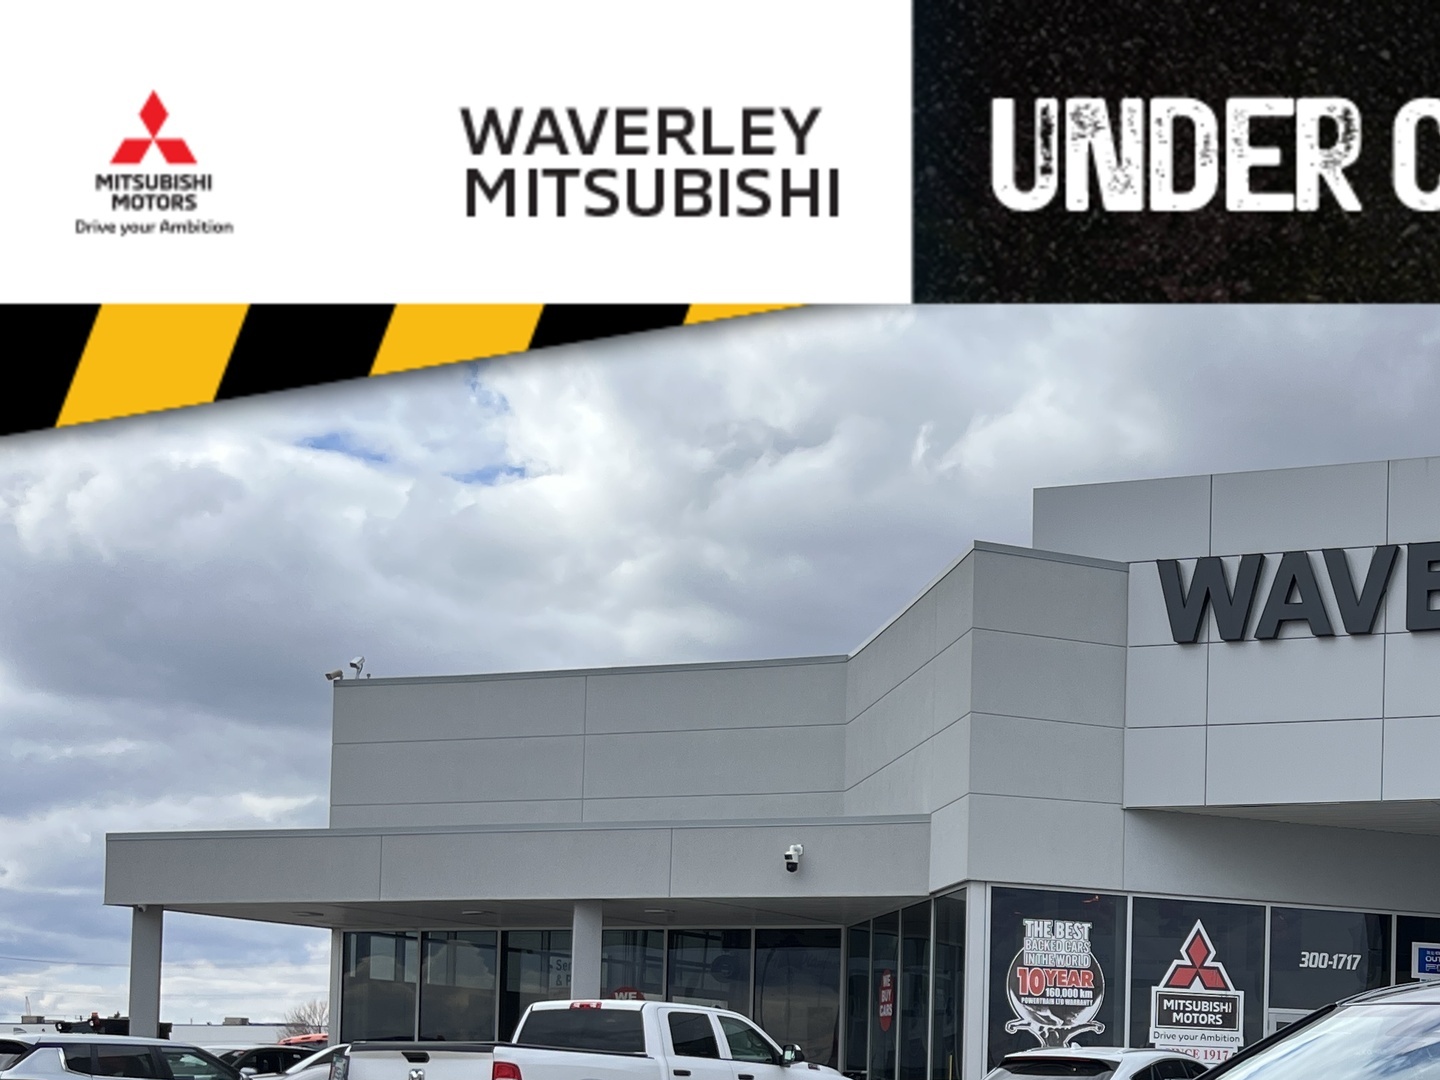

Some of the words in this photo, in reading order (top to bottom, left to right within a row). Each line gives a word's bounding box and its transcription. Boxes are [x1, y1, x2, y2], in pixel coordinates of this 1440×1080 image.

[1023, 919, 1053, 938] THE
[1054, 920, 1092, 941] BEST
[1025, 938, 1063, 953] BACKED
[1065, 940, 1091, 954] CARS
[1025, 952, 1035, 965] IN
[1035, 953, 1055, 966] THE
[1056, 953, 1090, 967] WORLD
[1299, 951, 1361, 970] 300-1717
[1017, 967, 1045, 996] 10
[1044, 968, 1094, 988] YEAR
[1045, 988, 1078, 999] 160,000
[1079, 989, 1093, 999] km
[1163, 999, 1232, 1013] MITSUBISHI
[1172, 1012, 1223, 1025] MOTORS
[1153, 1031, 1177, 1040] Drive
[1178, 1033, 1199, 1042] your
[1200, 1033, 1240, 1043] Ambition
[1203, 1049, 1229, 1061] 1917
